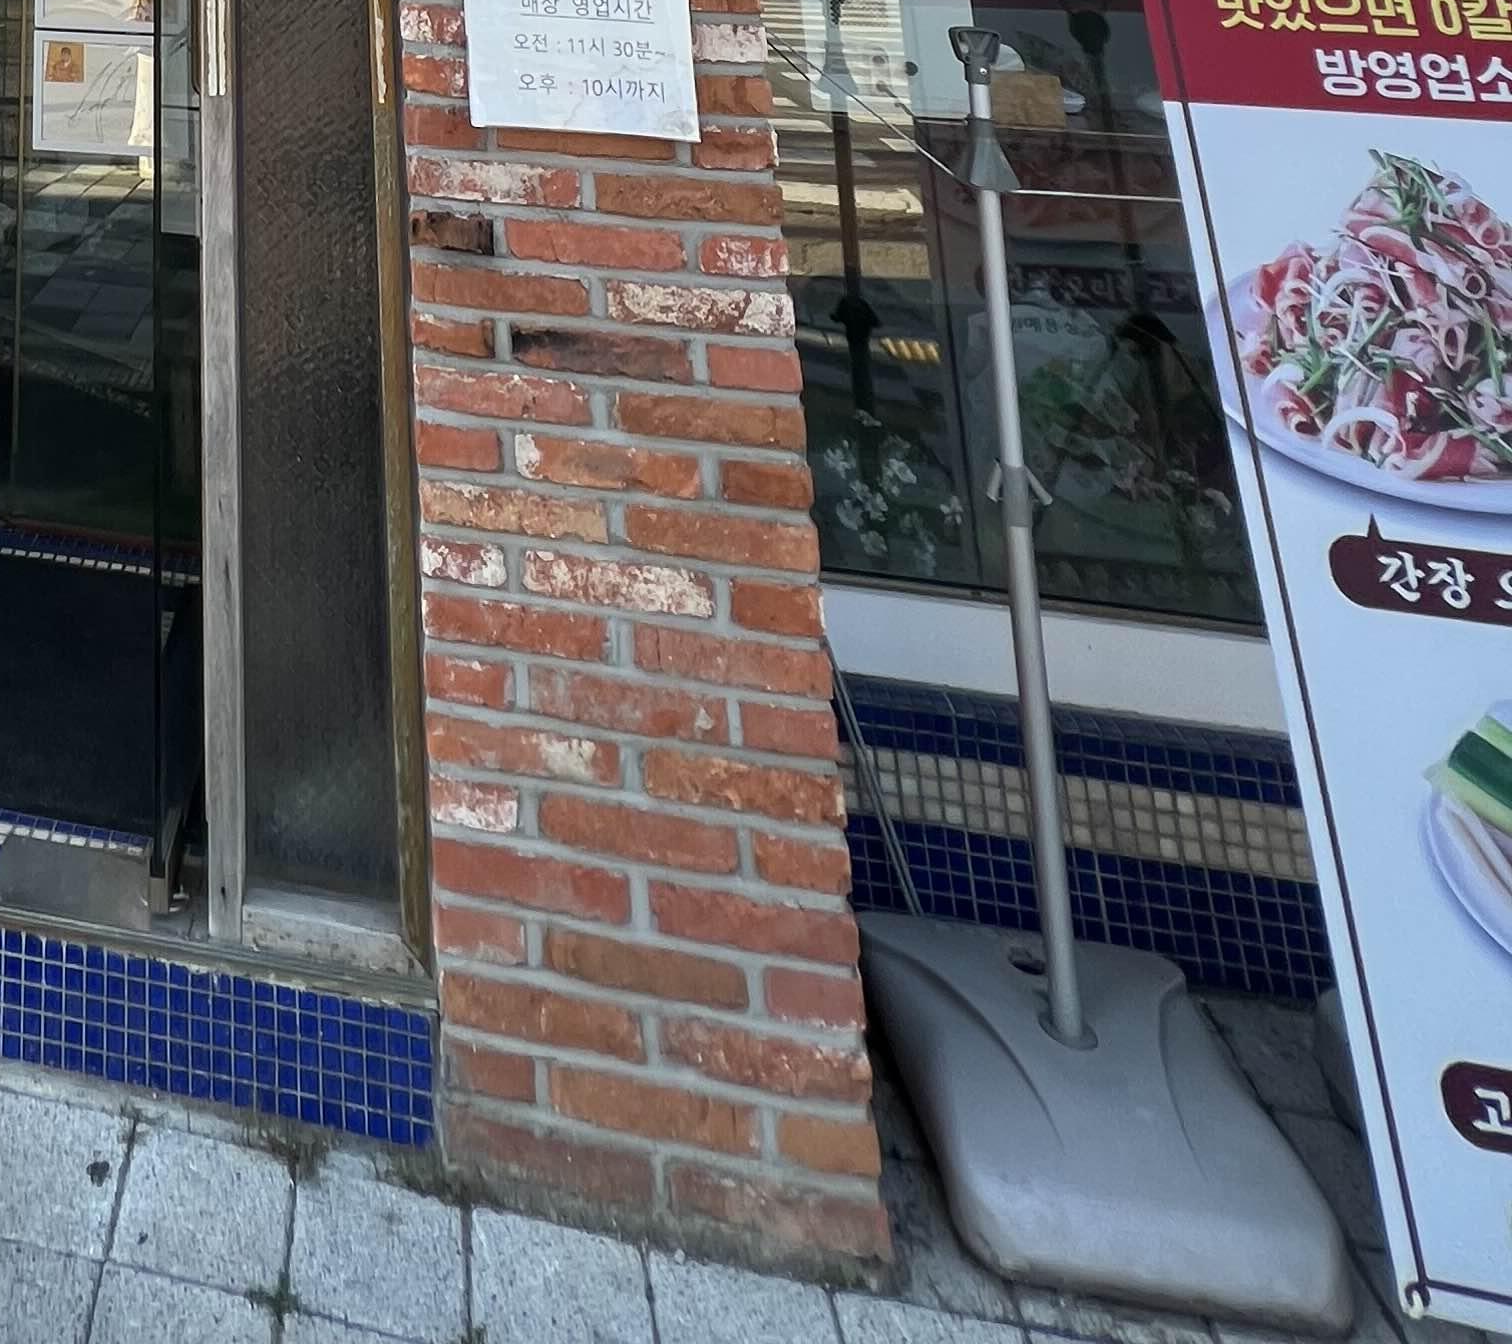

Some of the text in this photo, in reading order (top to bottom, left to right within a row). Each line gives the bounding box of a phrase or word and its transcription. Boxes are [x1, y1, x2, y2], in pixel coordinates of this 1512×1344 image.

[513, 33, 549, 54] 오전
[567, 36, 606, 57] 11시
[518, 72, 559, 93] 오후
[581, 78, 666, 104] 10시까지
[1313, 47, 1512, 104] 방영업소
[1376, 551, 1475, 610] 간장
